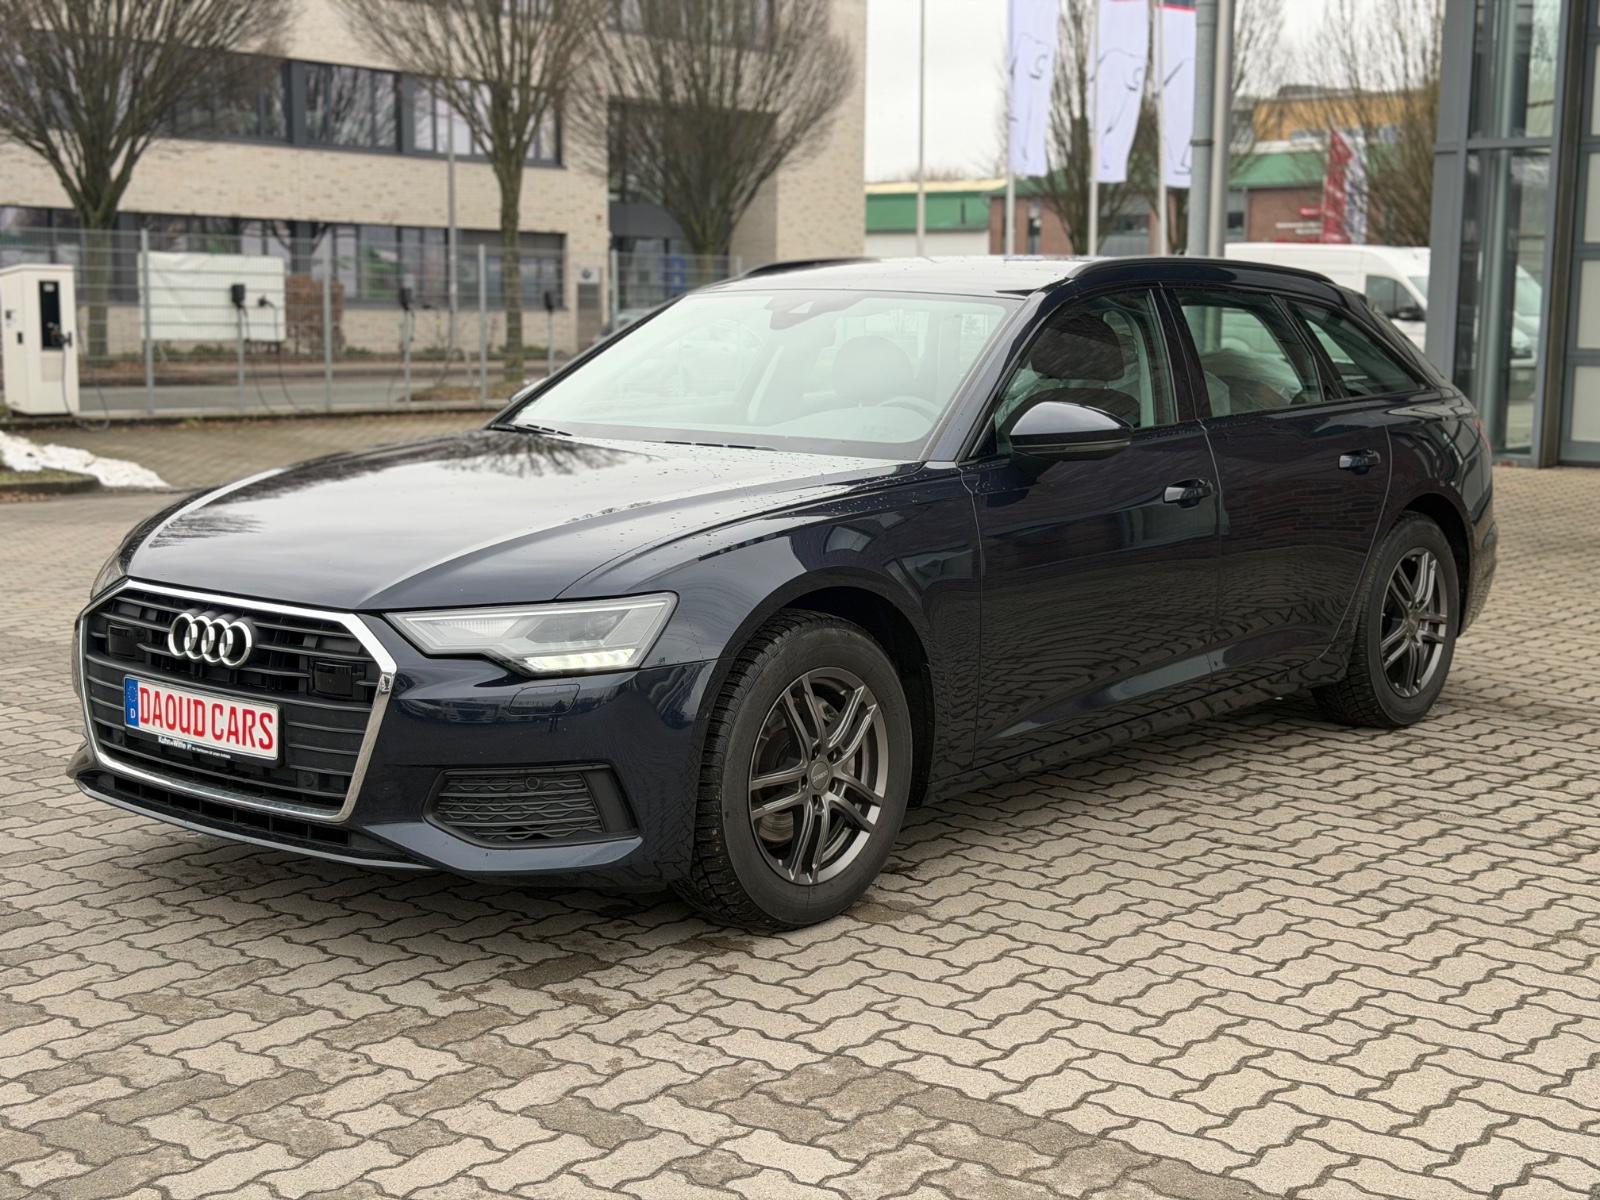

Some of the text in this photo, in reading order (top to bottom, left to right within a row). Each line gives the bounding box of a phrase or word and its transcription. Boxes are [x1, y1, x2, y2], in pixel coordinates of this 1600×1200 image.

[130, 708, 136, 719] D
[139, 687, 273, 750] DAOUD CARS
